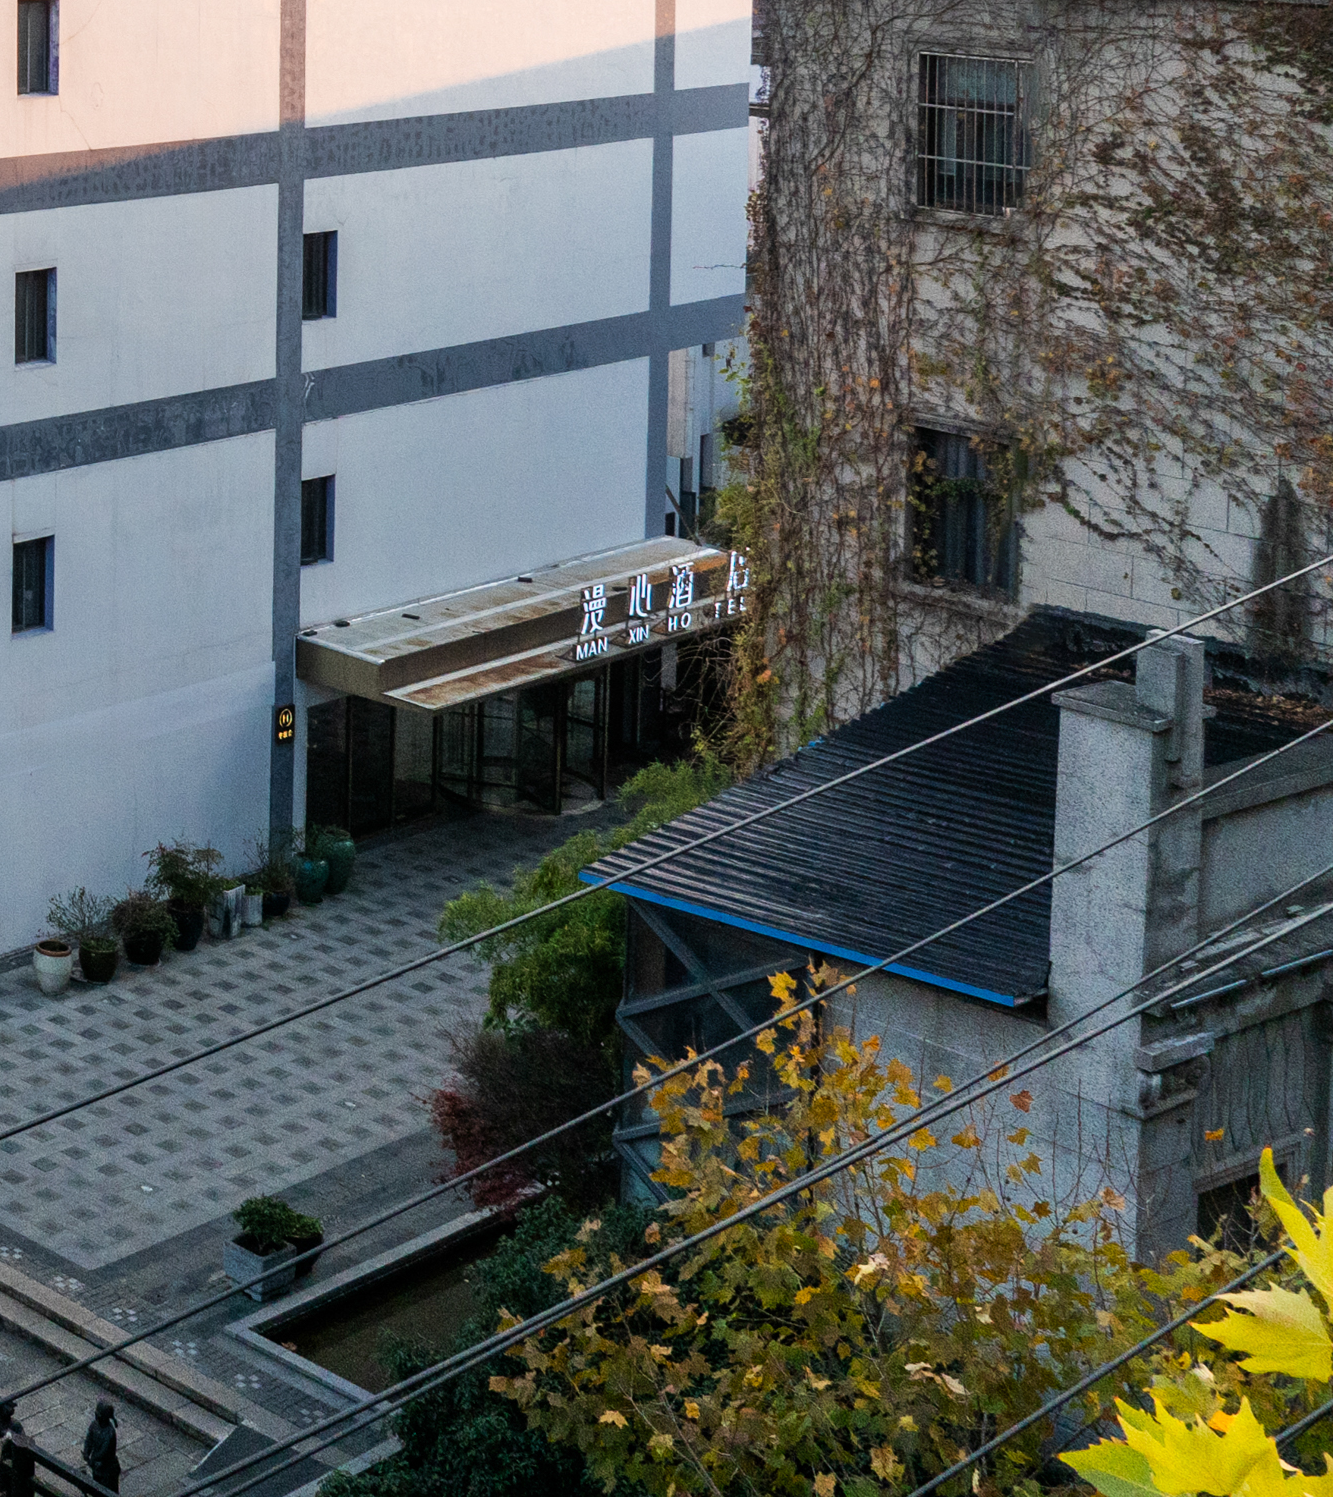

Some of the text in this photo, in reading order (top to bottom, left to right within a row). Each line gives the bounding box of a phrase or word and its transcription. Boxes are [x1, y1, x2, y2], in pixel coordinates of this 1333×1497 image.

[580, 548, 750, 635] 漫心酒店
[575, 636, 608, 661] MAN
[628, 624, 650, 645] XIN
